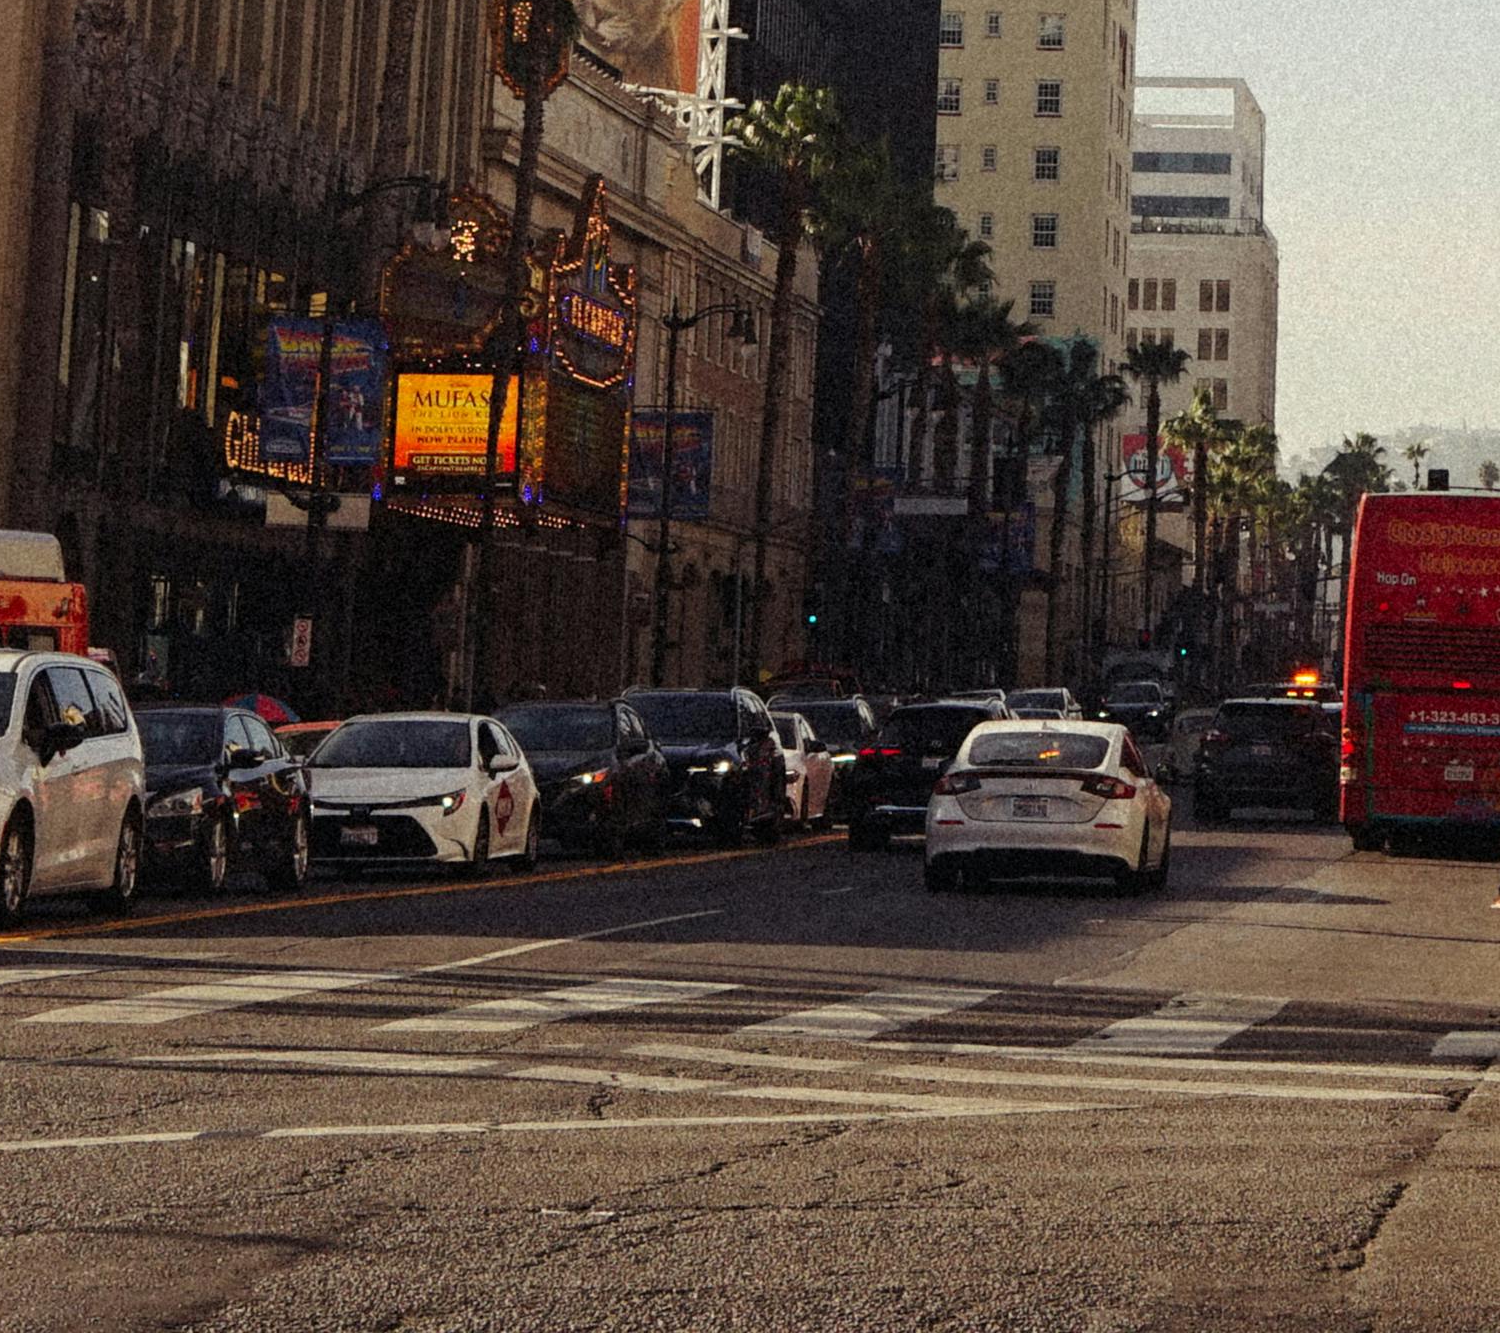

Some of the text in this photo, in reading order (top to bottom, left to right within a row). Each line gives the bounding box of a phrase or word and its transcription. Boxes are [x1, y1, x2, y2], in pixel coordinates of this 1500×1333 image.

[413, 390, 491, 408] MUFAS
[446, 436, 489, 446] PLAYIN
[468, 456, 489, 467] NO
[1376, 571, 1399, 587] Hop
